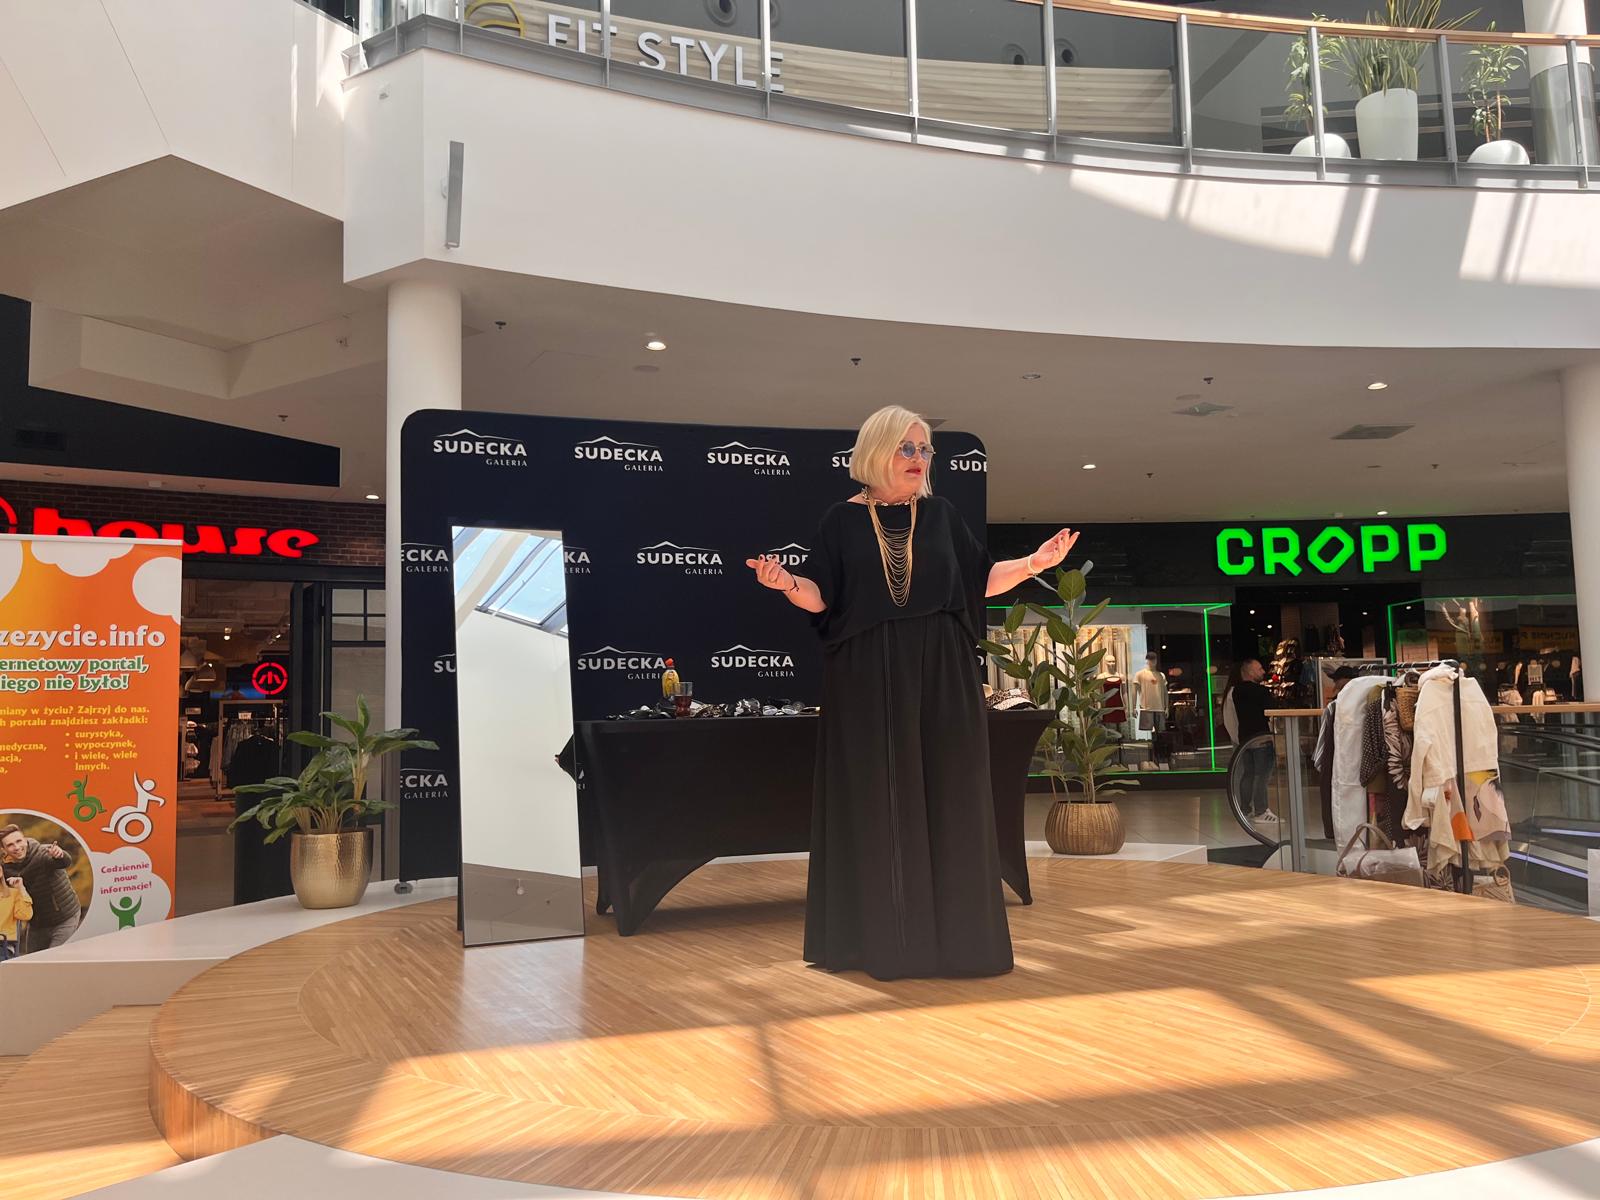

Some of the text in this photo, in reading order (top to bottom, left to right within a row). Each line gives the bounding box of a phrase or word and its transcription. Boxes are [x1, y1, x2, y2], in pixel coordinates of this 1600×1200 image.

[637, 32, 785, 93] STYLE
[433, 439, 528, 457] SUDECKA
[574, 446, 663, 462] SUDECKA
[485, 458, 528, 467] GALERIA
[706, 452, 791, 467] SUDECKA
[624, 464, 664, 472] GALERIA
[753, 468, 791, 476] GALERIA
[33, 507, 321, 558] house
[1215, 523, 1448, 577] CROPP
[636, 552, 723, 565] SUDECKA
[405, 565, 449, 573] GALERIA
[88, 655, 149, 674] portal,
[576, 657, 667, 670] SUDECKA
[711, 655, 794, 668] SUDECKA
[44, 674, 74, 691] nie
[78, 673, 130, 693] było!
[627, 672, 661, 681] GALERI
[77, 705, 111, 716] Zajrzyj
[114, 704, 128, 713] do
[130, 705, 150, 713] nas.
[9, 717, 47, 728] portalu
[50, 716, 99, 727] znajdziesz
[75, 730, 125, 740] turystyka,
[74, 739, 137, 750] wypoczynek,
[81, 751, 110, 761] wiele,
[113, 750, 138, 760] wiele
[400, 774, 448, 788] CKA
[404, 790, 449, 799] GALERIA
[101, 861, 150, 874] Codziennie
[113, 874, 138, 883] nowe
[100, 881, 152, 895] informacje!
